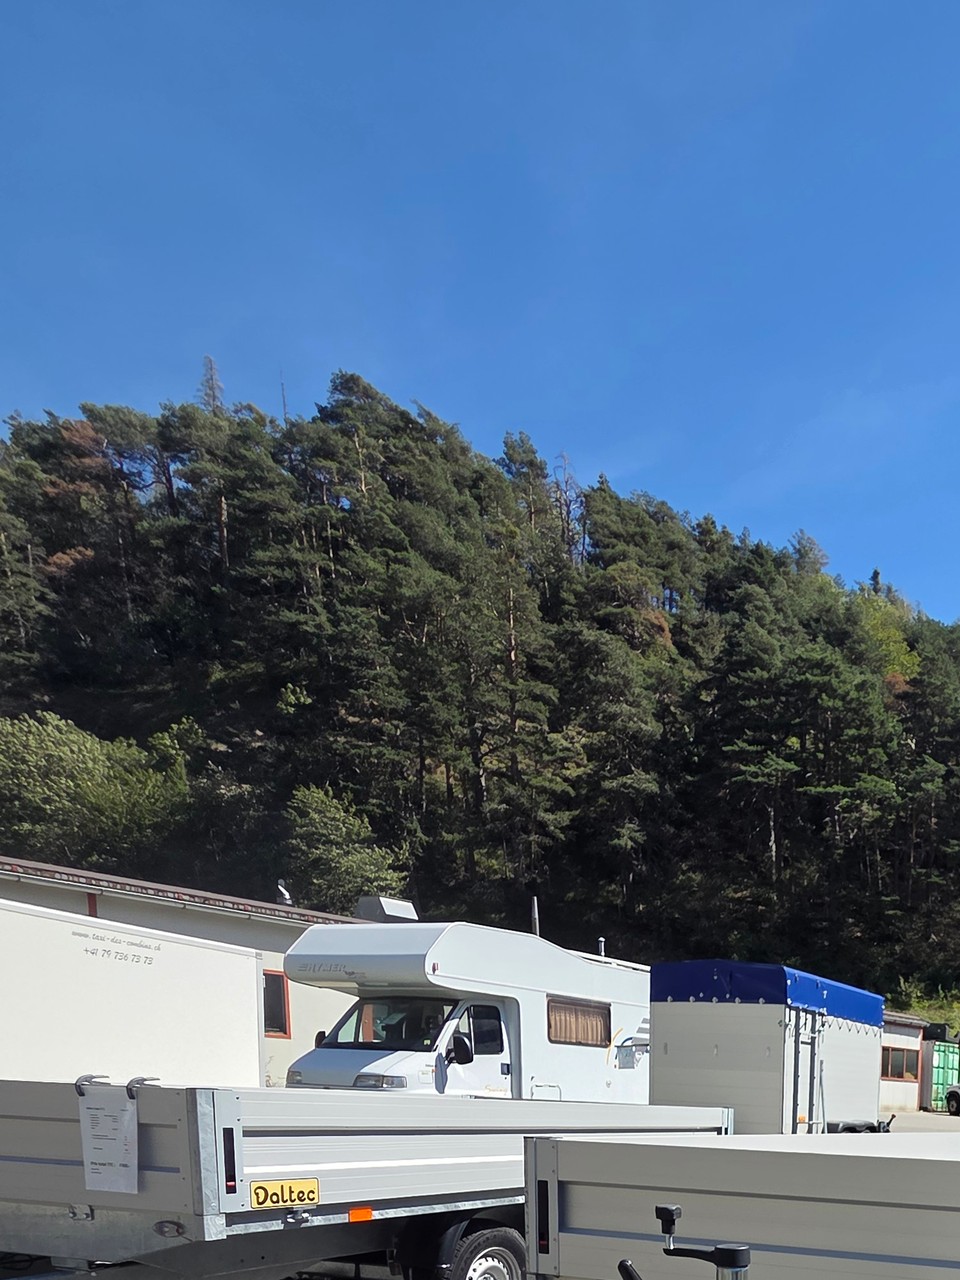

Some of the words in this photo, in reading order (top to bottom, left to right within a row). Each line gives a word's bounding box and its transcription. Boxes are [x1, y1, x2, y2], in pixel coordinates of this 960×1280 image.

[101, 948, 112, 958] 79
[114, 950, 129, 961] 736
[131, 953, 142, 963] 73
[143, 955, 154, 966] 73
[254, 1184, 316, 1206] Daltec
